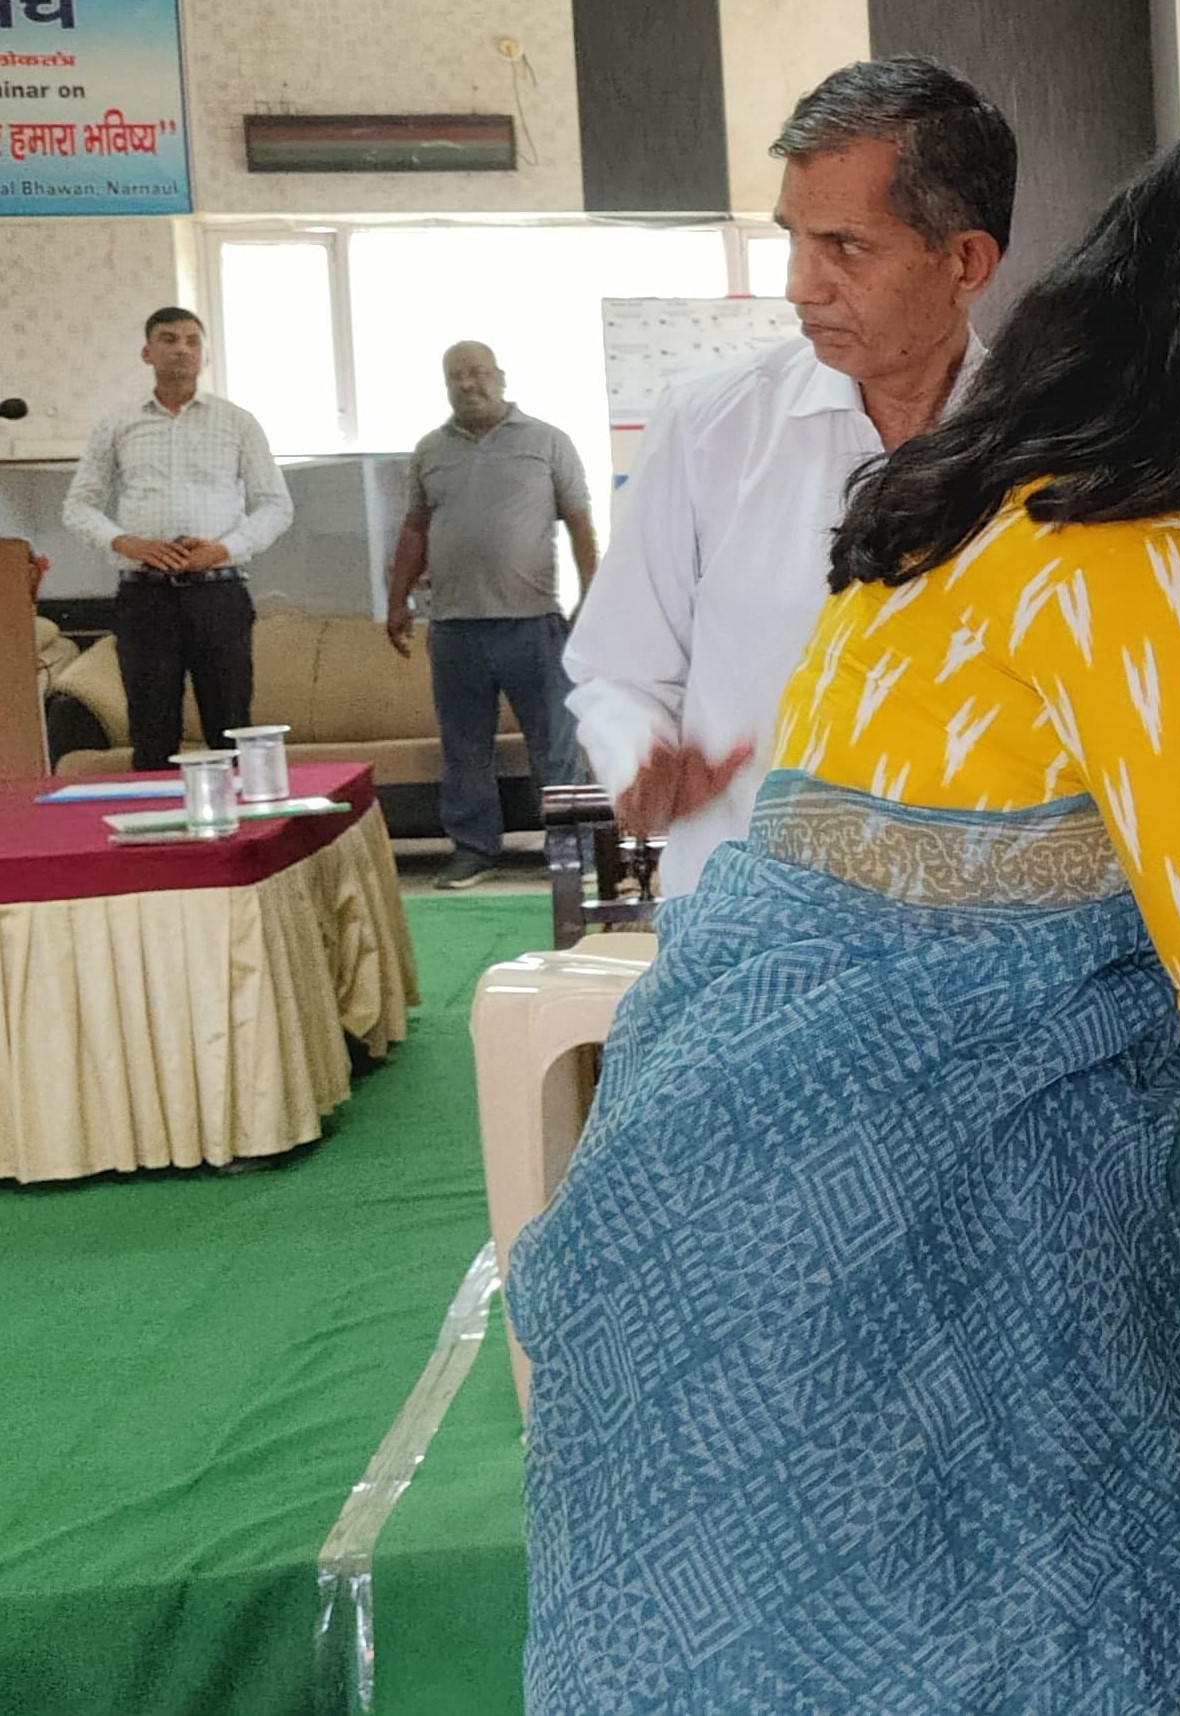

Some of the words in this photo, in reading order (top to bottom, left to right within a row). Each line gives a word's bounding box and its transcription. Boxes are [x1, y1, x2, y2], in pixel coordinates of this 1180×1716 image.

[0, 81, 49, 98] inar
[58, 85, 86, 98] on
[8, 123, 76, 161] हमारा
[107, 181, 179, 195] Narnaul
